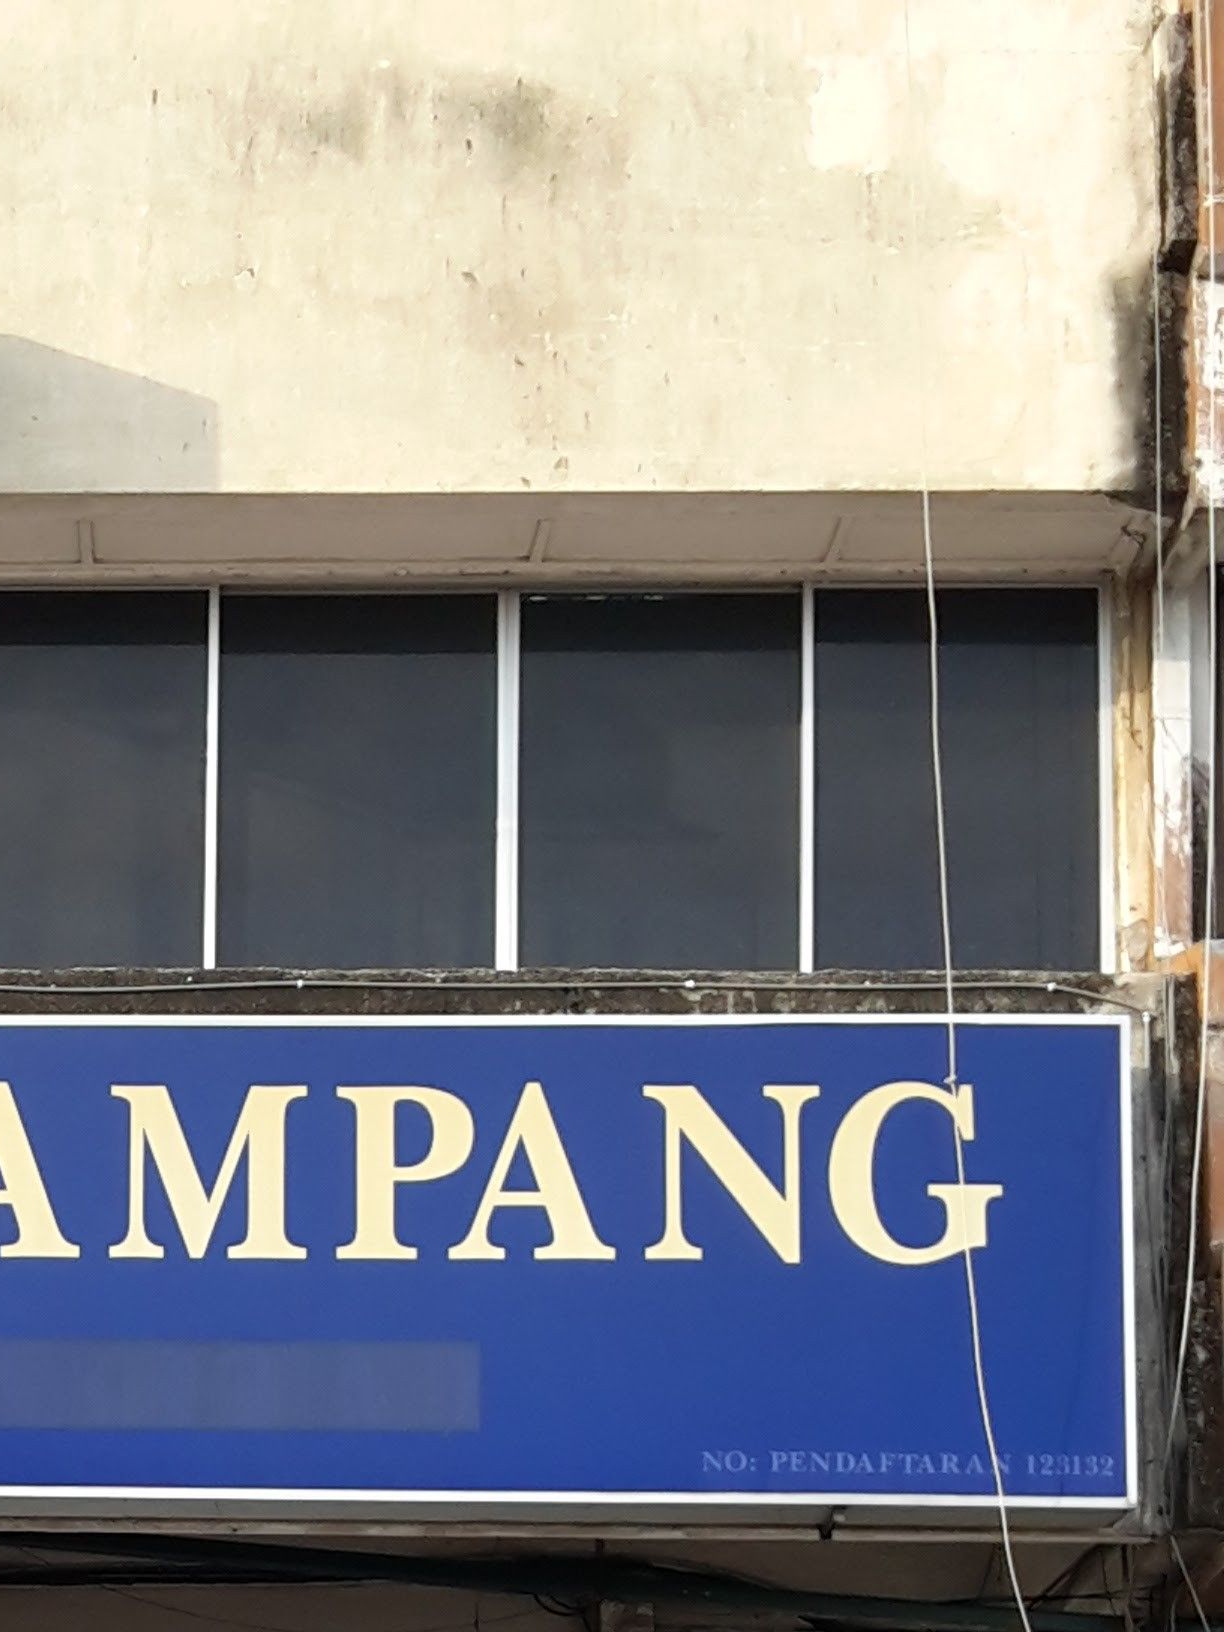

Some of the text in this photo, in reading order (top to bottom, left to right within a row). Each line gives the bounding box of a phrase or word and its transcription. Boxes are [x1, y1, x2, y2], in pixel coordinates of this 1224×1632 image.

[701, 1451, 1117, 1477] NO: PENDAFTARAN 123132
